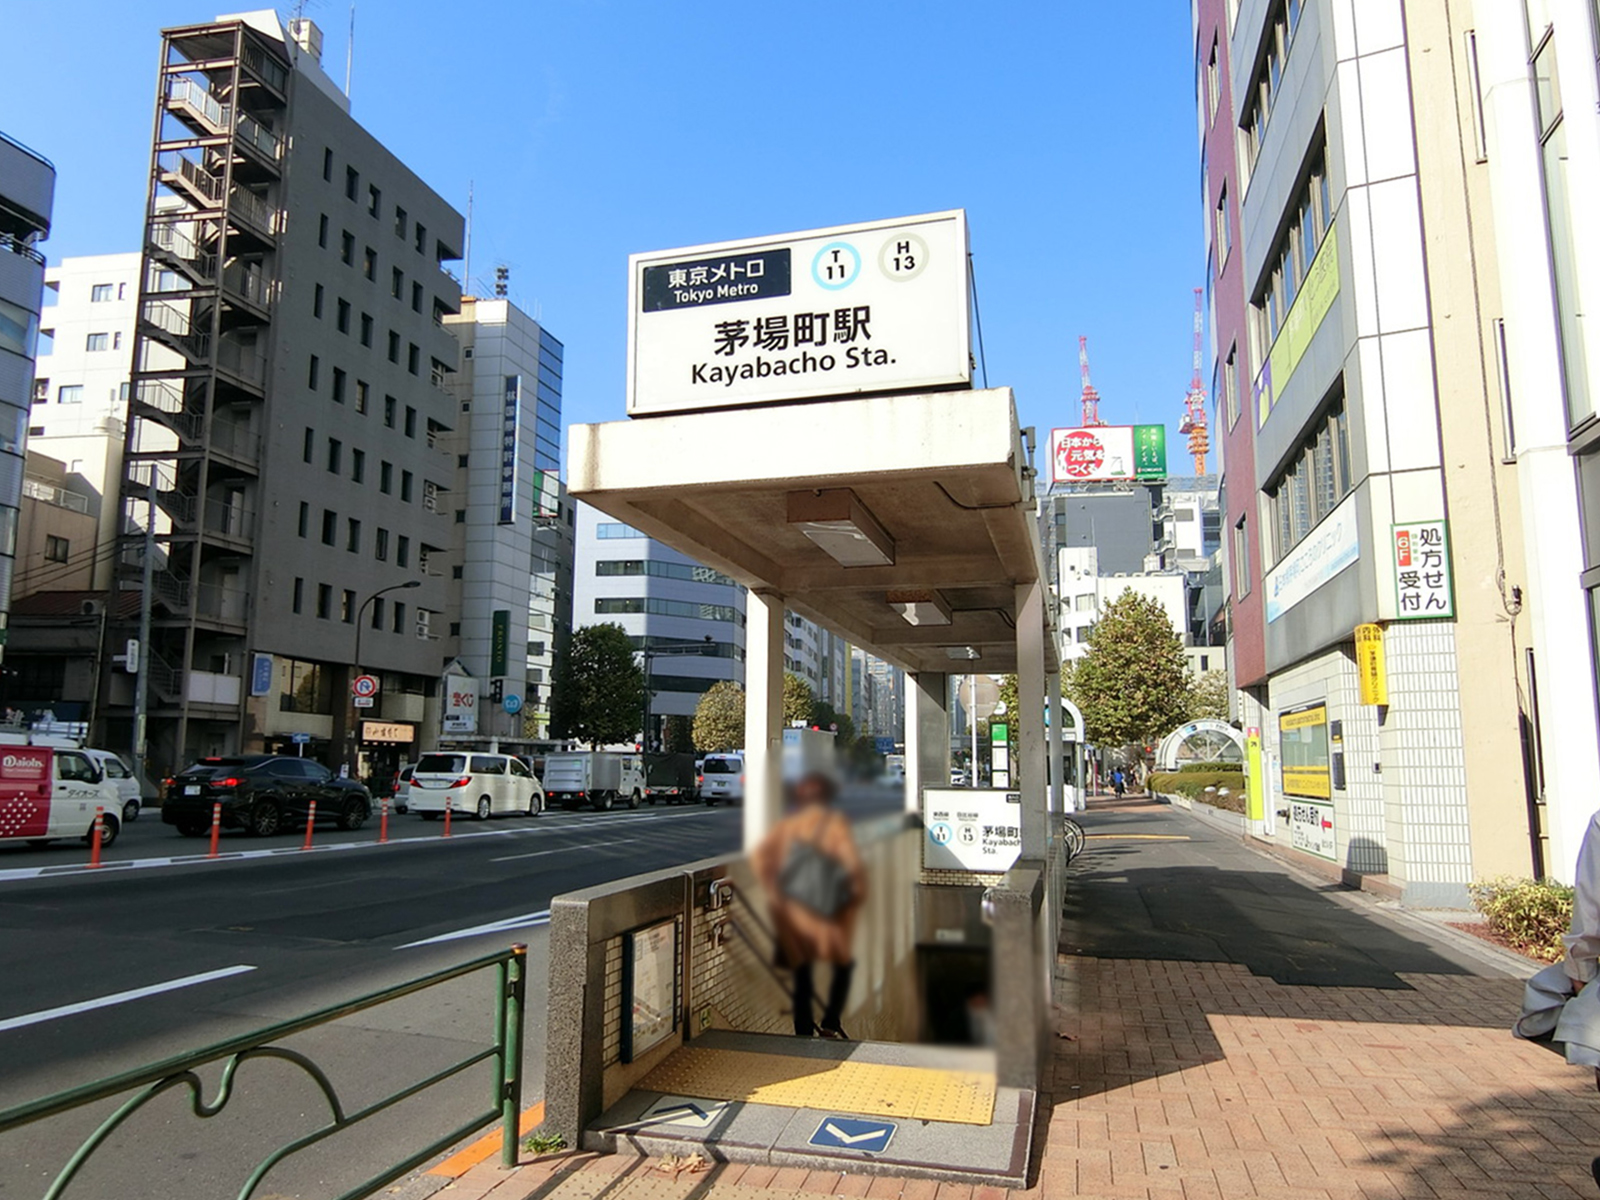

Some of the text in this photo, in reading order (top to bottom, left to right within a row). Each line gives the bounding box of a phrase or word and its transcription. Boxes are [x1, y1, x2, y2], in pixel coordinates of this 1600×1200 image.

[831, 250, 841, 263] T
[896, 240, 910, 255] H
[667, 259, 765, 288] 東京メトロ
[826, 264, 846, 280] 11
[893, 256, 915, 271] 13
[674, 282, 758, 304] Tokyo Metro
[713, 305, 871, 357] 茅場町駅
[692, 346, 896, 387] Kayabacho Sta.
[1397, 536, 1409, 560] 6F
[1420, 528, 1446, 610] 処方せん
[1399, 570, 1421, 611] 受付
[982, 826, 1021, 838] 茅場町
[982, 838, 1021, 847] Kayabach
